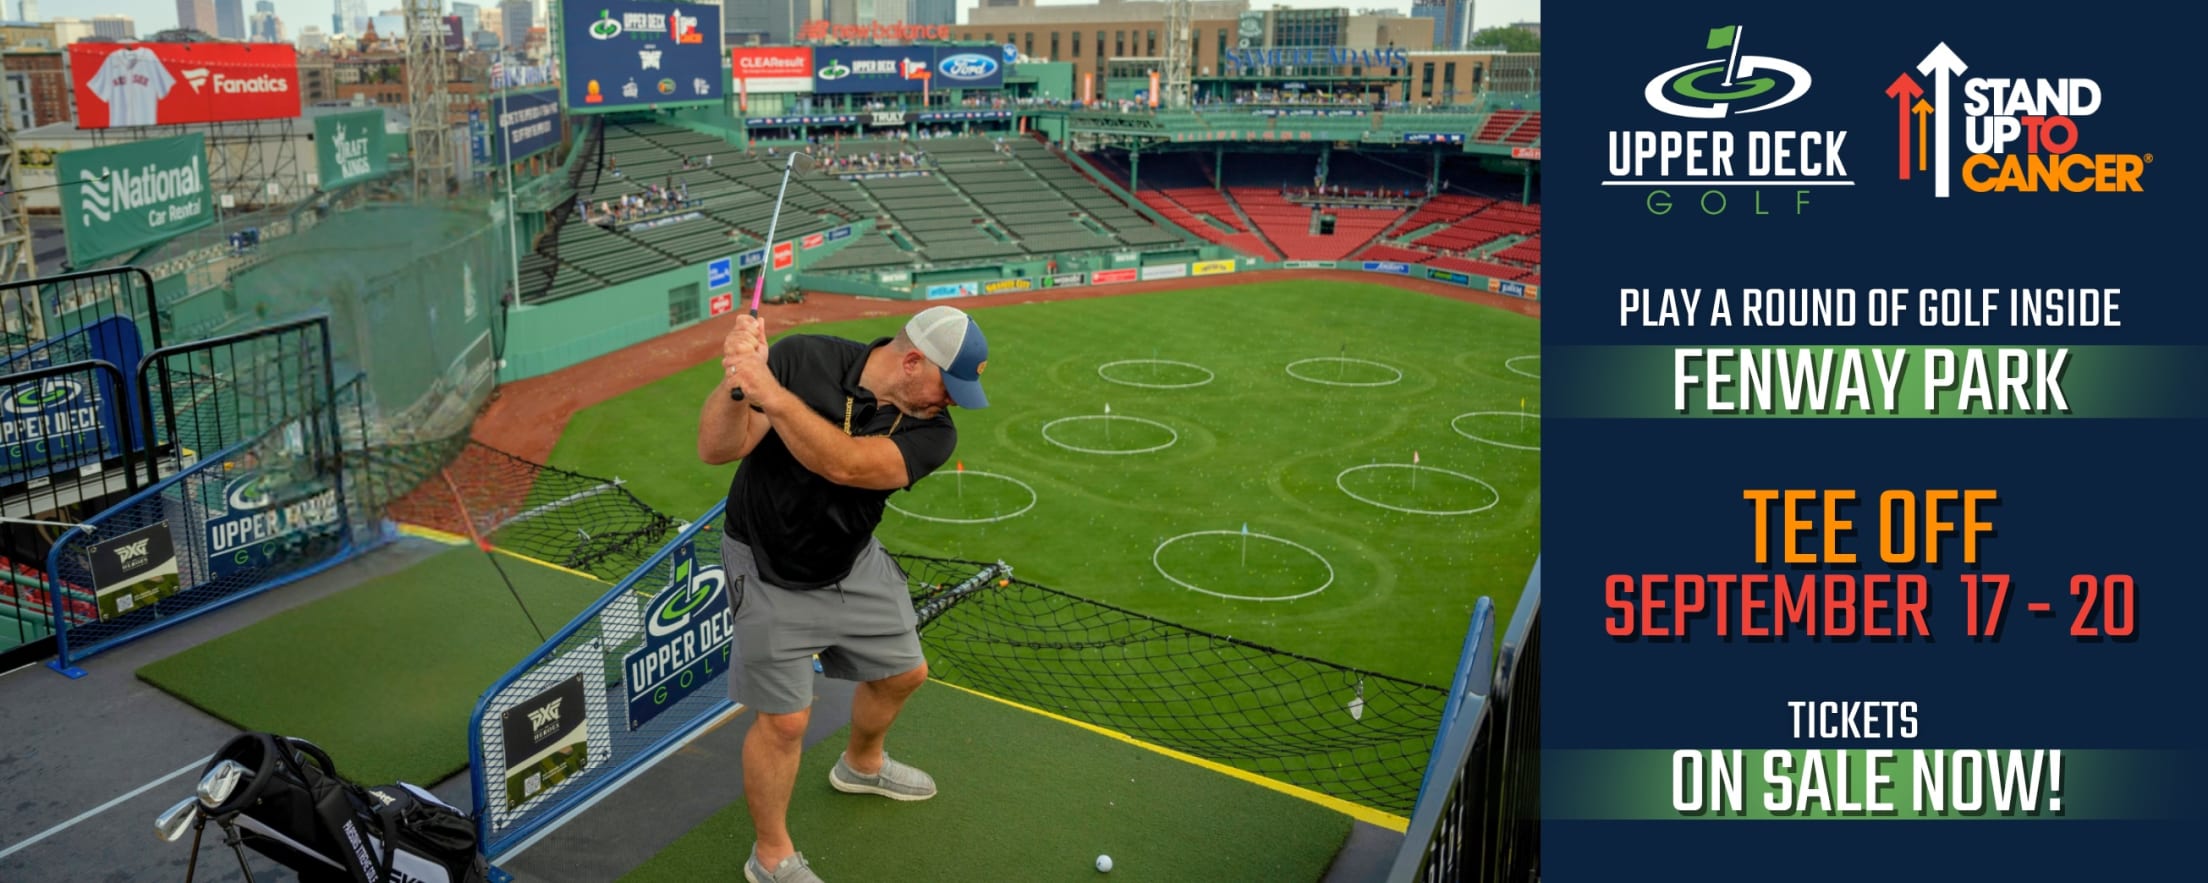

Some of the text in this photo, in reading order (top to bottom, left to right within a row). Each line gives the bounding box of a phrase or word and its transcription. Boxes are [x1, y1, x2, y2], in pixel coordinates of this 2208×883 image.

[623, 12, 647, 30] UPPER
[647, 14, 666, 30] DECK
[832, 23, 870, 40] new
[871, 19, 949, 41] balance
[740, 56, 804, 68] CLEAResult
[852, 60, 876, 73] UPPER
[877, 60, 896, 73] DECK
[950, 60, 988, 76] Ford
[1225, 47, 1408, 70] SAMUEL ADAMS
[213, 73, 289, 95] Fanatics
[112, 155, 201, 213] National
[149, 198, 202, 227] Car Rental
[0, 415, 51, 443] PPER
[212, 508, 279, 550] UPPER
[632, 608, 733, 693] UPPER DEC
[654, 645, 729, 704] GOLF
